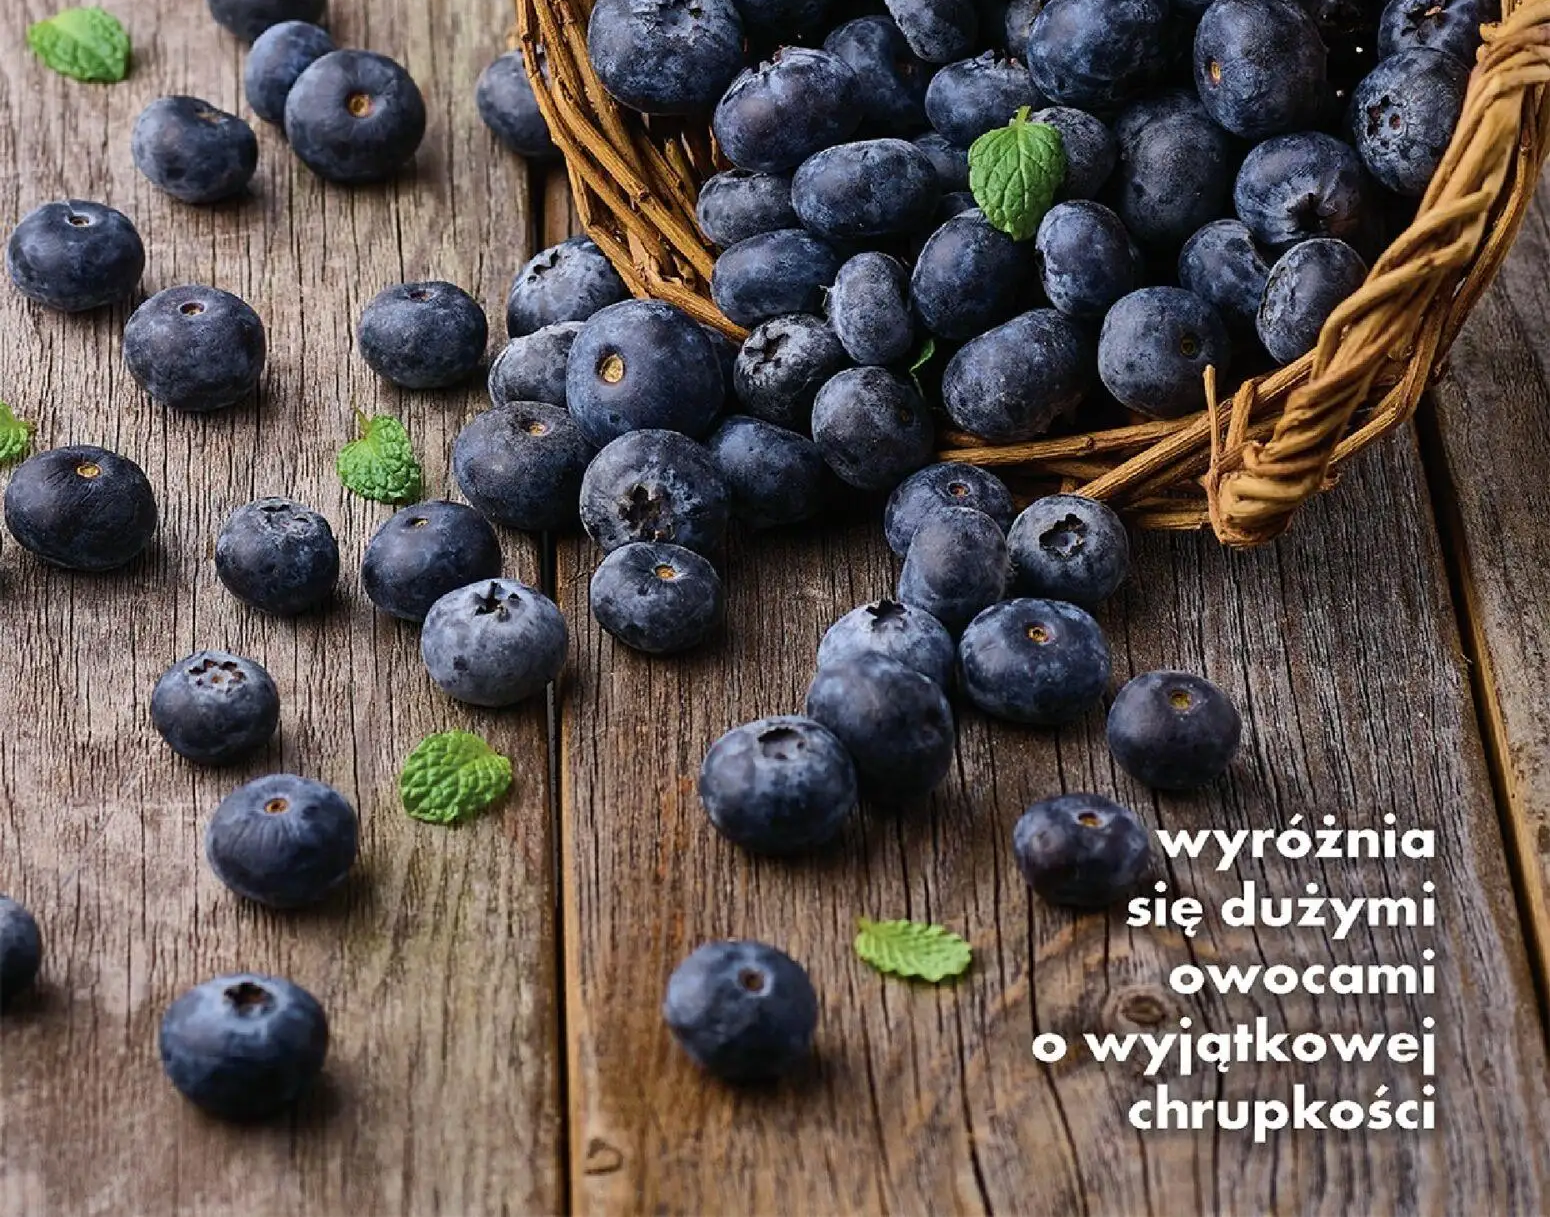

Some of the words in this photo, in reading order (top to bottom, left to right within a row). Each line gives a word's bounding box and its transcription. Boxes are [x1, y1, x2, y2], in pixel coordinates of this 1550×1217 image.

[1156, 814, 1435, 872] wyróżnia
[1126, 881, 1203, 938] się
[1221, 880, 1435, 939] dużymi
[1169, 949, 1435, 995] owocami
[1031, 1031, 1066, 1063] o
[1084, 1017, 1435, 1076] wyjątkowej
[1128, 1085, 1435, 1144] chrupkości
